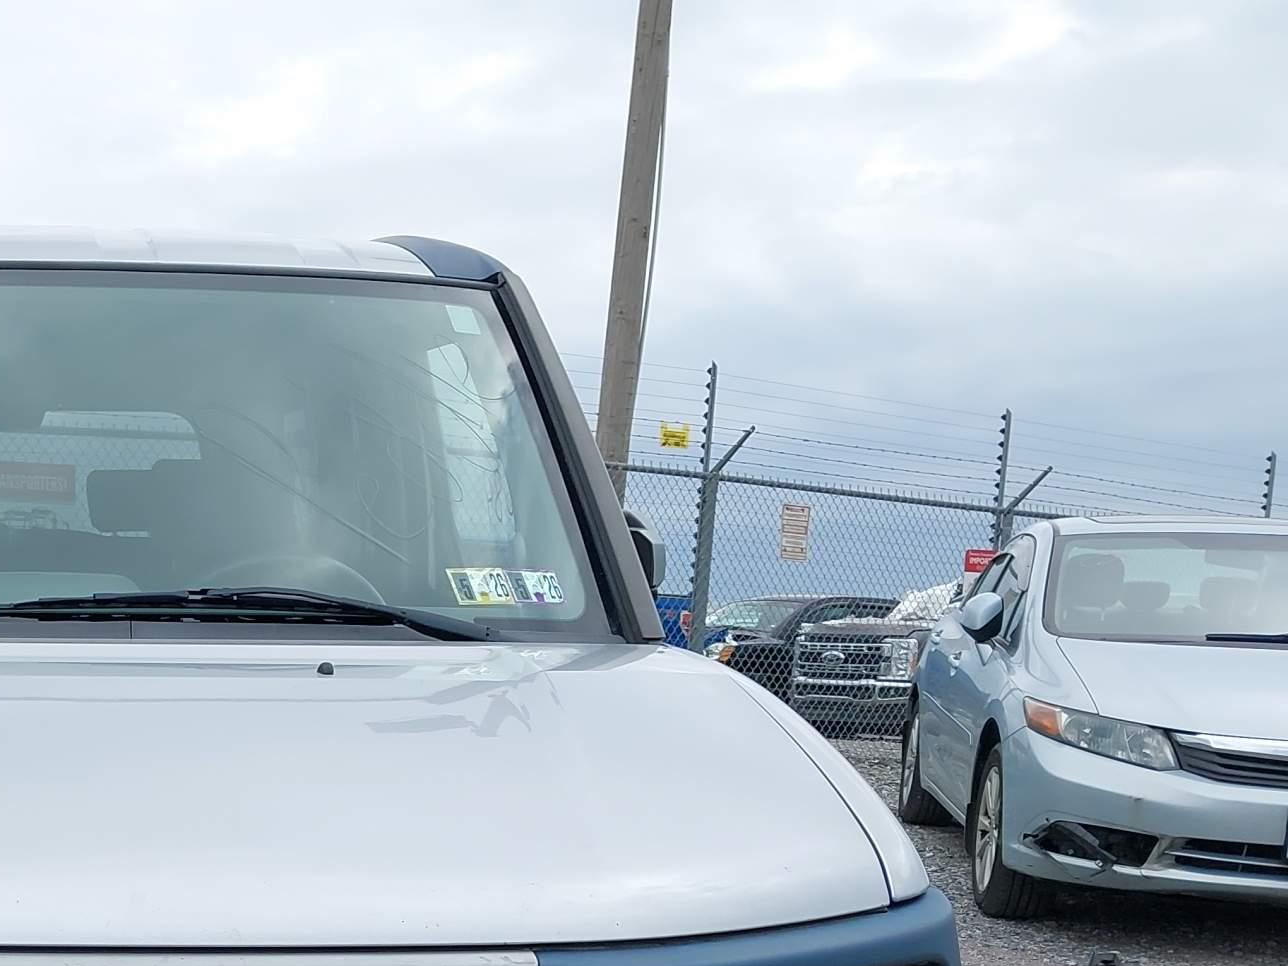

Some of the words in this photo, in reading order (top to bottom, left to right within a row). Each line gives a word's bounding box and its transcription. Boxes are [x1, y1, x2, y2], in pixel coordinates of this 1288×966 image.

[458, 578, 474, 600] 5
[489, 573, 510, 598] 26
[543, 575, 563, 599] 26
